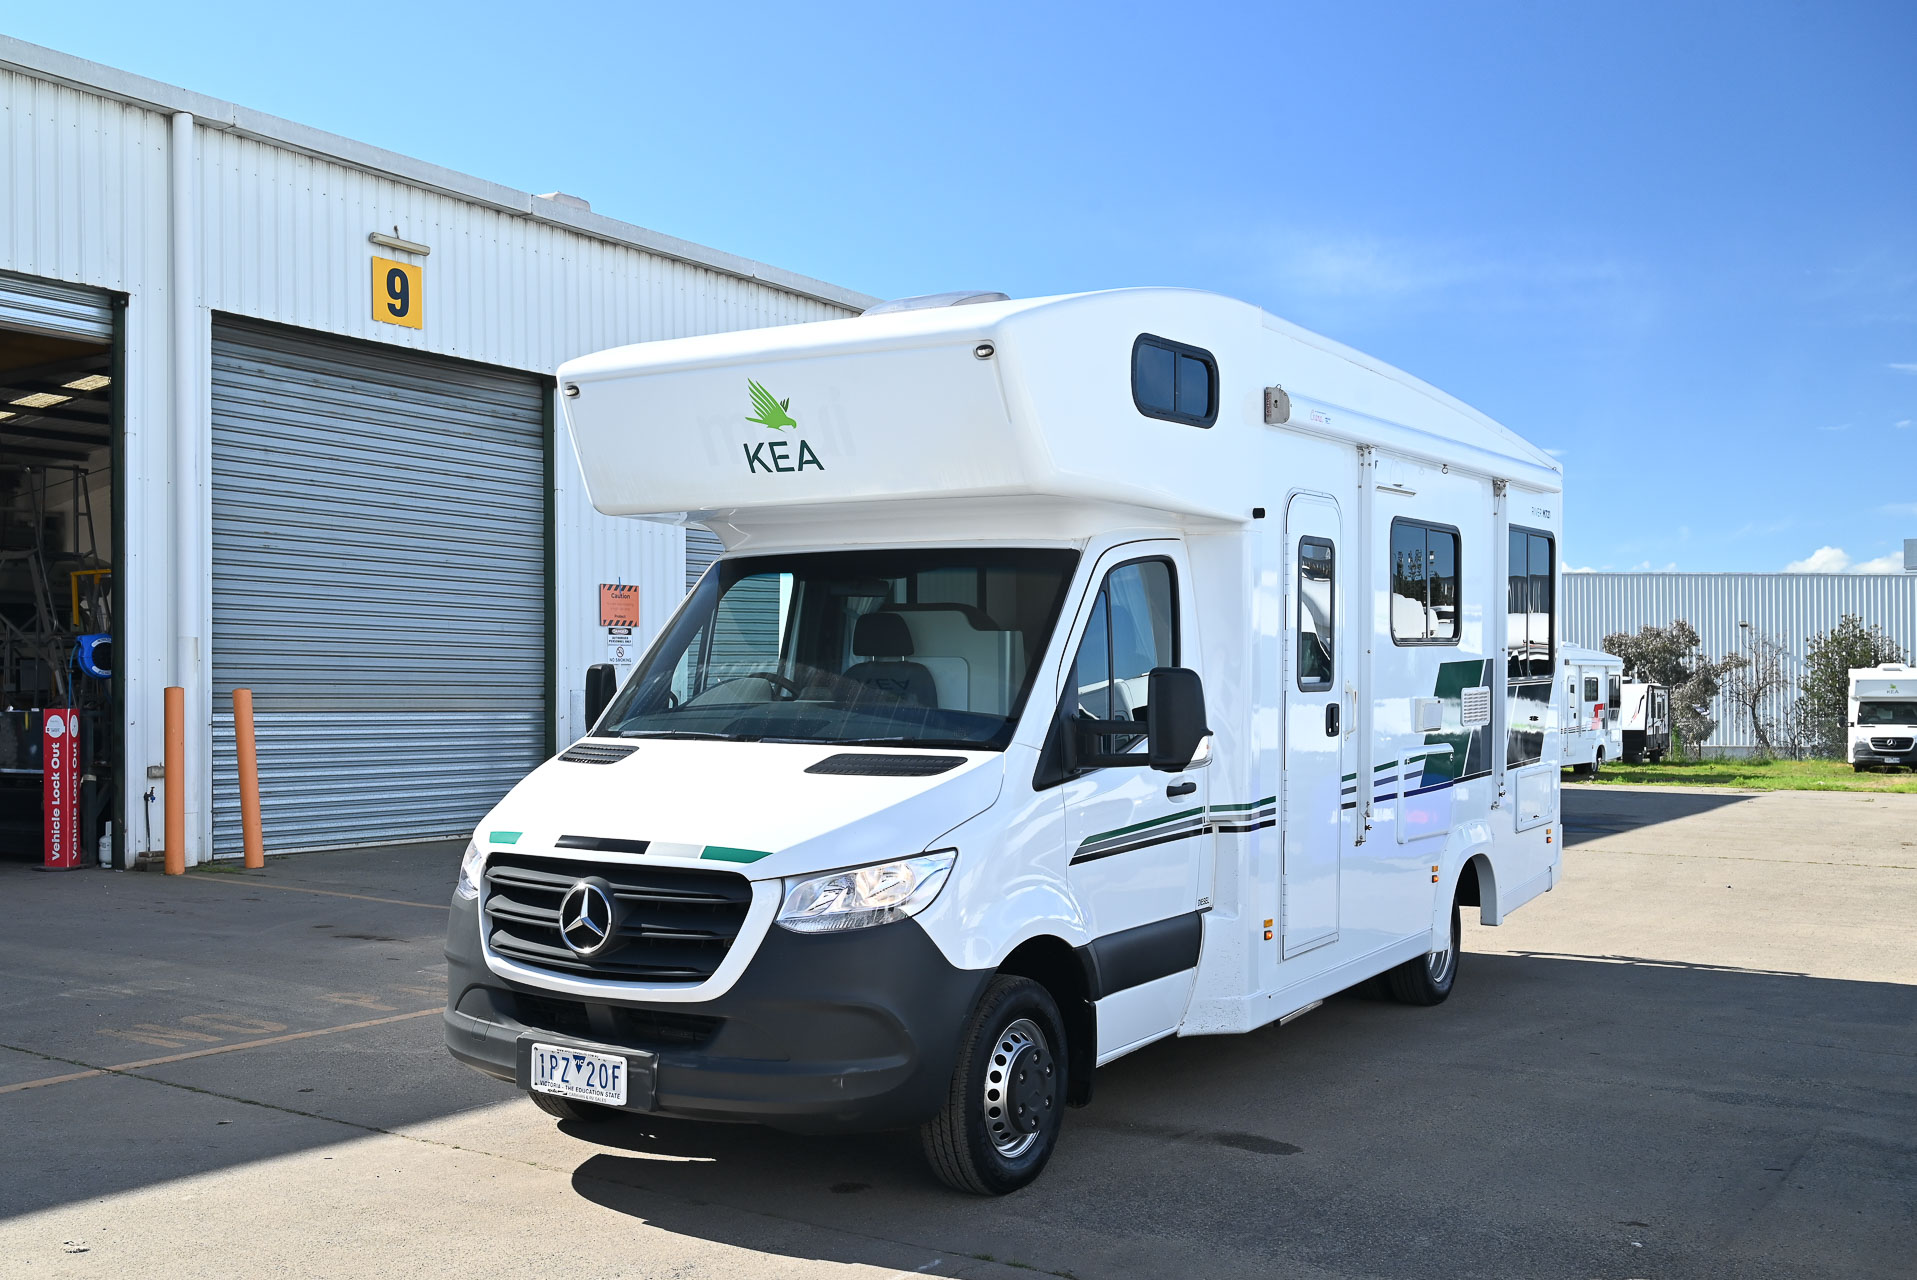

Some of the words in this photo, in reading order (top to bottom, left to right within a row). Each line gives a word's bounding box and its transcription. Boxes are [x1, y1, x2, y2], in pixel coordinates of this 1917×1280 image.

[386, 268, 409, 317] 9
[743, 439, 825, 473] KEA
[51, 742, 60, 769] Out
[51, 772, 60, 805] Lock
[51, 808, 60, 860] Vehicle
[1197, 896, 1210, 906] DIESEL
[540, 1080, 560, 1089] VICTORIA
[575, 1087, 604, 1097] EDUCATION
[605, 1091, 621, 1099] STATE
